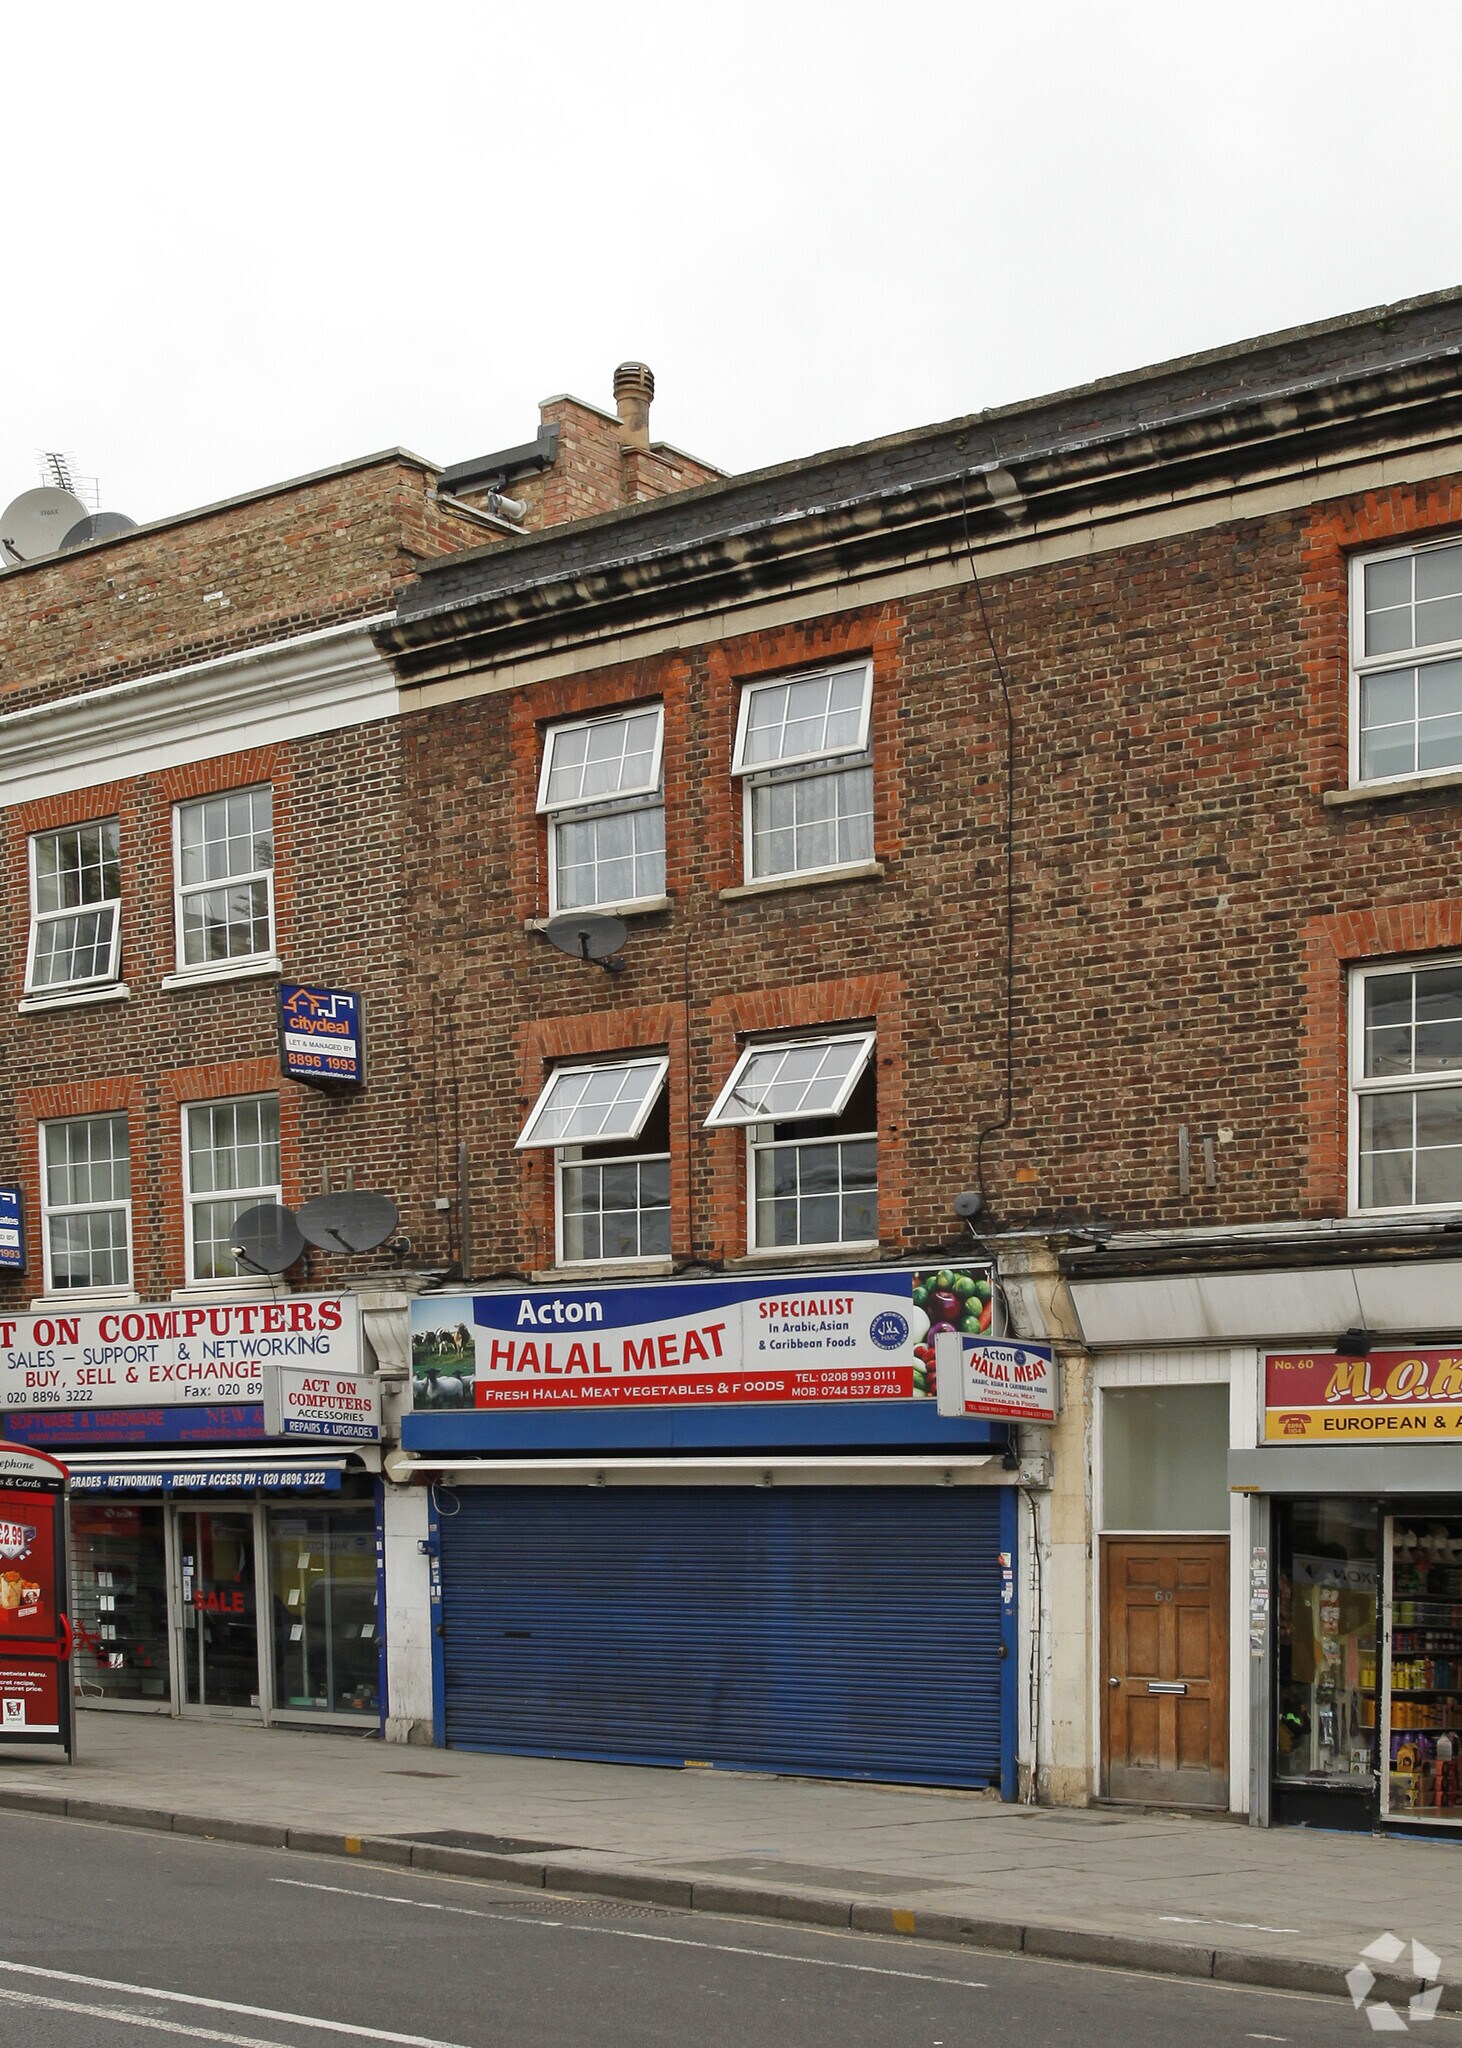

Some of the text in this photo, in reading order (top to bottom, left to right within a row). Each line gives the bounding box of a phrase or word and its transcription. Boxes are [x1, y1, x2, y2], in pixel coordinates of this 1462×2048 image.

[290, 1016, 349, 1034] citydeal
[309, 1041, 342, 1051] MANAGED
[289, 1053, 356, 1071] 8896 1993
[517, 1299, 603, 1326] Acton
[759, 1298, 854, 1318] SPECIALIST
[33, 1318, 81, 1346] ON
[99, 1301, 342, 1342] COMPUTERS
[769, 1323, 778, 1333] In
[490, 1323, 726, 1374] HALAL MEAT
[759, 1337, 856, 1350] & Caribbean Foods
[8, 1350, 55, 1369] SALES
[84, 1345, 159, 1365] SUPPORT
[178, 1343, 190, 1360] &
[203, 1335, 330, 1359] NETWORKING
[982, 1348, 1013, 1362] Acton
[970, 1353, 1047, 1383] HALAL MEAT
[1275, 1359, 1314, 1370] No. 60
[26, 1361, 261, 1388] BUY, SELL & EXCHANGE
[796, 1371, 896, 1382] TEL: 0208 993 0111
[7, 1383, 262, 1403] 020 8896 3222 Fax: 020 89
[302, 1379, 330, 1392] ACT
[337, 1382, 357, 1395] ON
[486, 1390, 529, 1400] FRESH
[533, 1389, 578, 1399] HALAL
[581, 1387, 620, 1398] MEAT
[717, 1383, 729, 1394] &
[792, 1385, 901, 1396] MOB: 0744 537 8783
[1009, 1383, 1033, 1392] CARIBBEAN
[288, 1393, 372, 1411] COMPUTERS
[10, 1413, 75, 1430] SOFTWARE
[81, 1414, 89, 1427] &
[95, 1410, 164, 1426] HARDWARE
[207, 1408, 246, 1424] NEW
[297, 1409, 364, 1421] ACCESSORIES
[1324, 1416, 1426, 1430] EUROPEAN
[1434, 1416, 1446, 1428] &
[289, 1421, 373, 1437] REPAIRS & UPGRADES
[5, 1478, 14, 1486] &
[16, 1478, 41, 1488] Cards
[70, 1476, 101, 1488] GRADES
[108, 1475, 162, 1487] NETWORKING
[172, 1474, 207, 1486] REMOTE
[208, 1474, 242, 1486] ACCESS
[244, 1474, 256, 1485] PH
[263, 1473, 278, 1485] 020
[281, 1473, 301, 1484] 8896
[304, 1472, 326, 1484] 3222
[193, 1590, 244, 1613] SALE
[1155, 1591, 1172, 1601] 60
